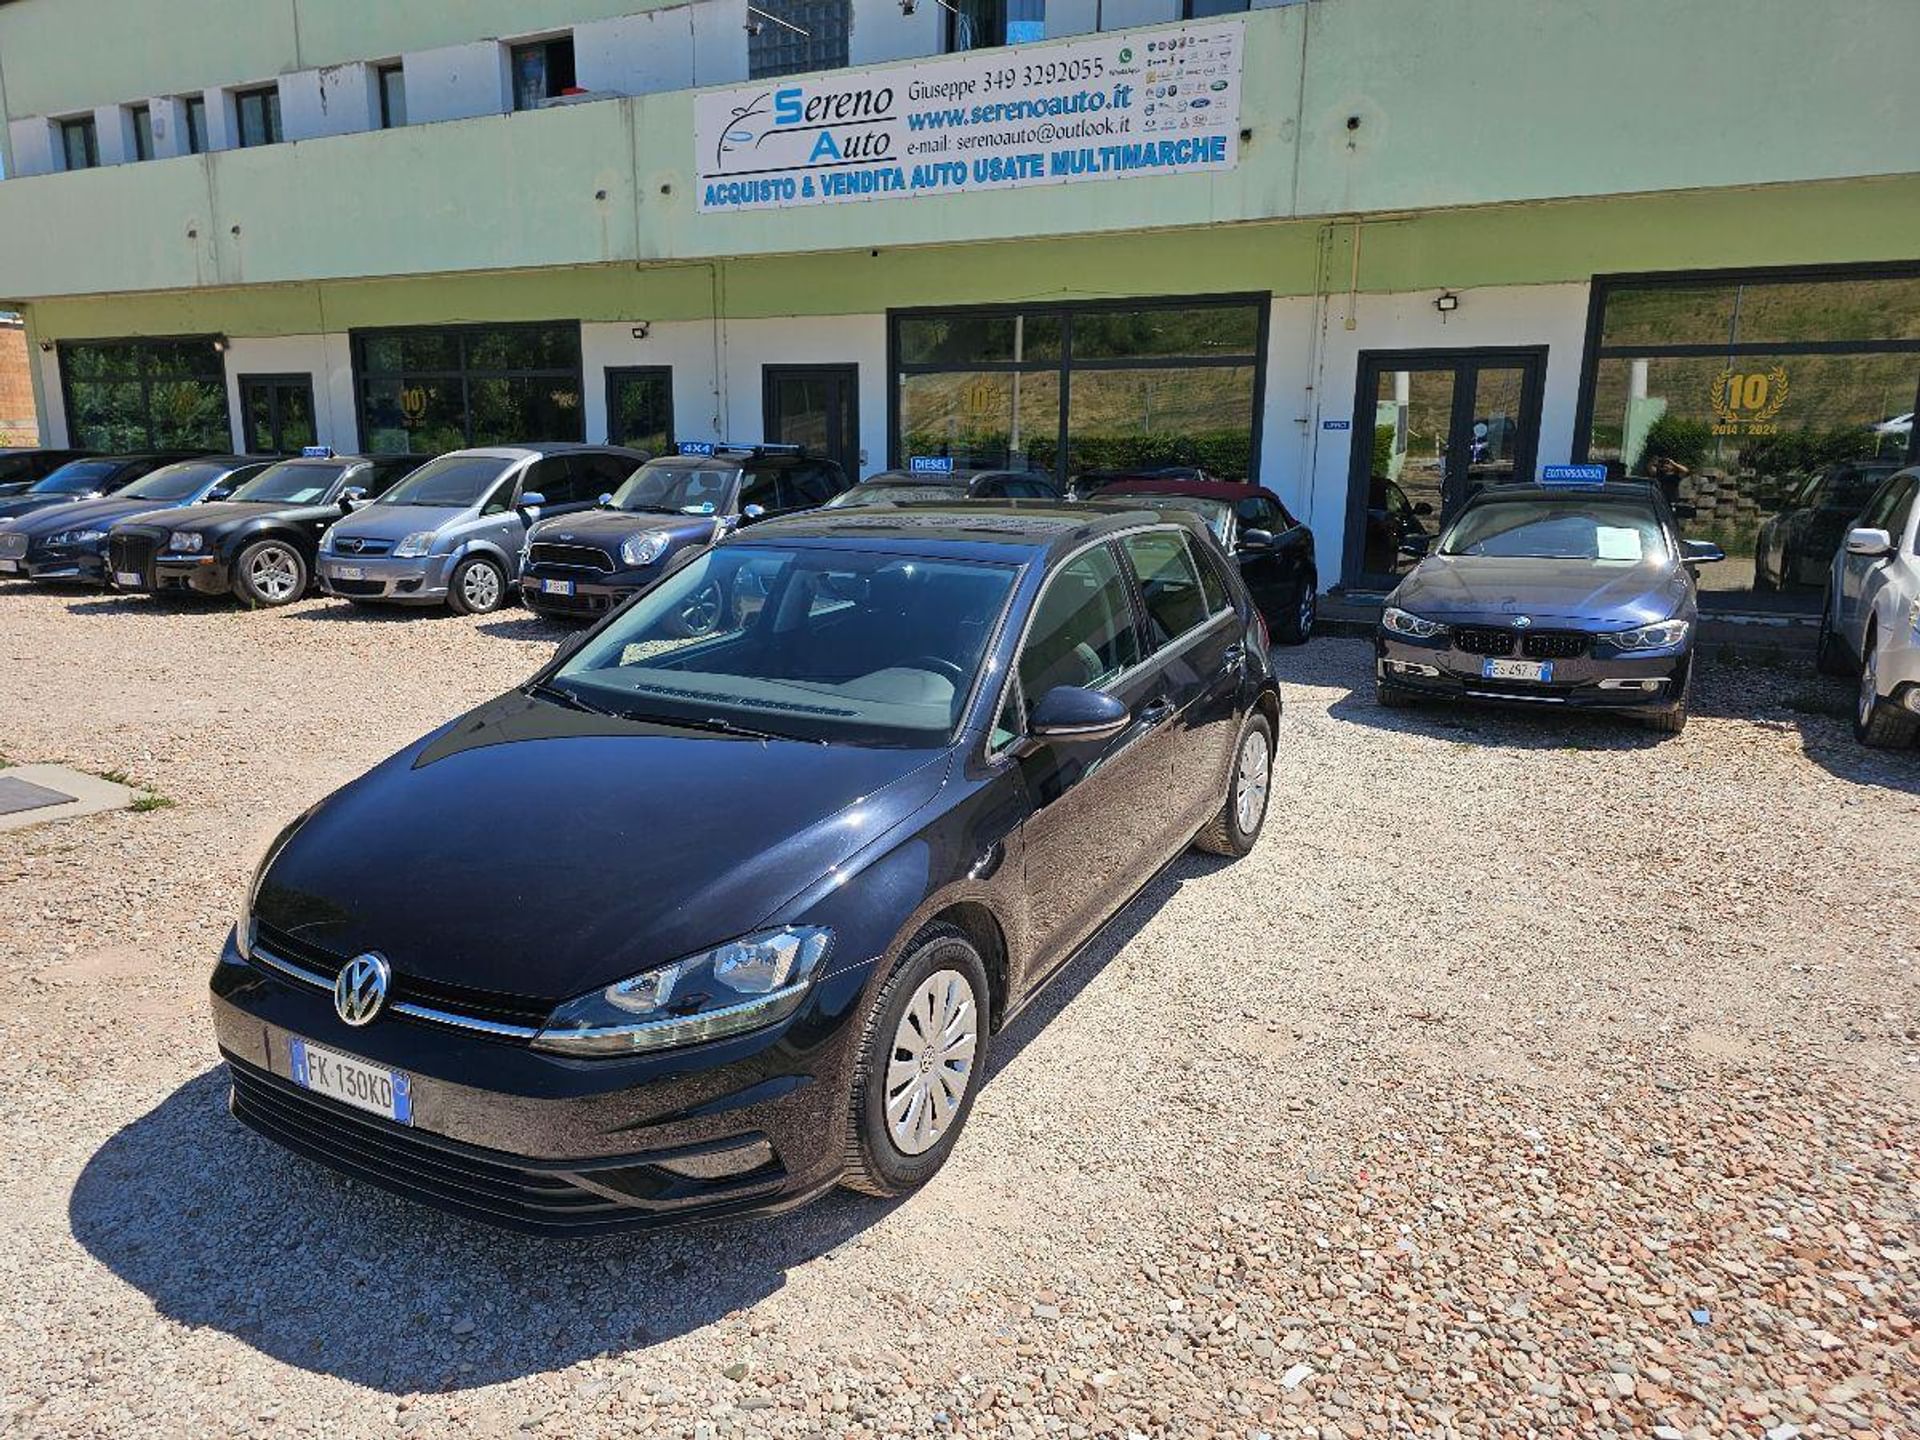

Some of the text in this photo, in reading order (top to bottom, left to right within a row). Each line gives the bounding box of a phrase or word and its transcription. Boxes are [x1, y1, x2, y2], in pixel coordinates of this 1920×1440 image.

[907, 57, 1104, 101] Giuseppe 349 3292055
[774, 87, 894, 124] Sereno
[907, 83, 1134, 131] www.serenoauto.it
[808, 130, 891, 164] Auto
[906, 115, 1131, 155] e-mail: serenoauto@outlook.it
[704, 135, 1228, 206] ACQUISTO & VENDITA AUTO USATE MULTIMARCHE
[1711, 423, 1738, 436] 2014
[1748, 423, 1778, 436] 2024
[914, 458, 949, 471] DIESEL
[307, 1051, 392, 1108] FK 130KD
